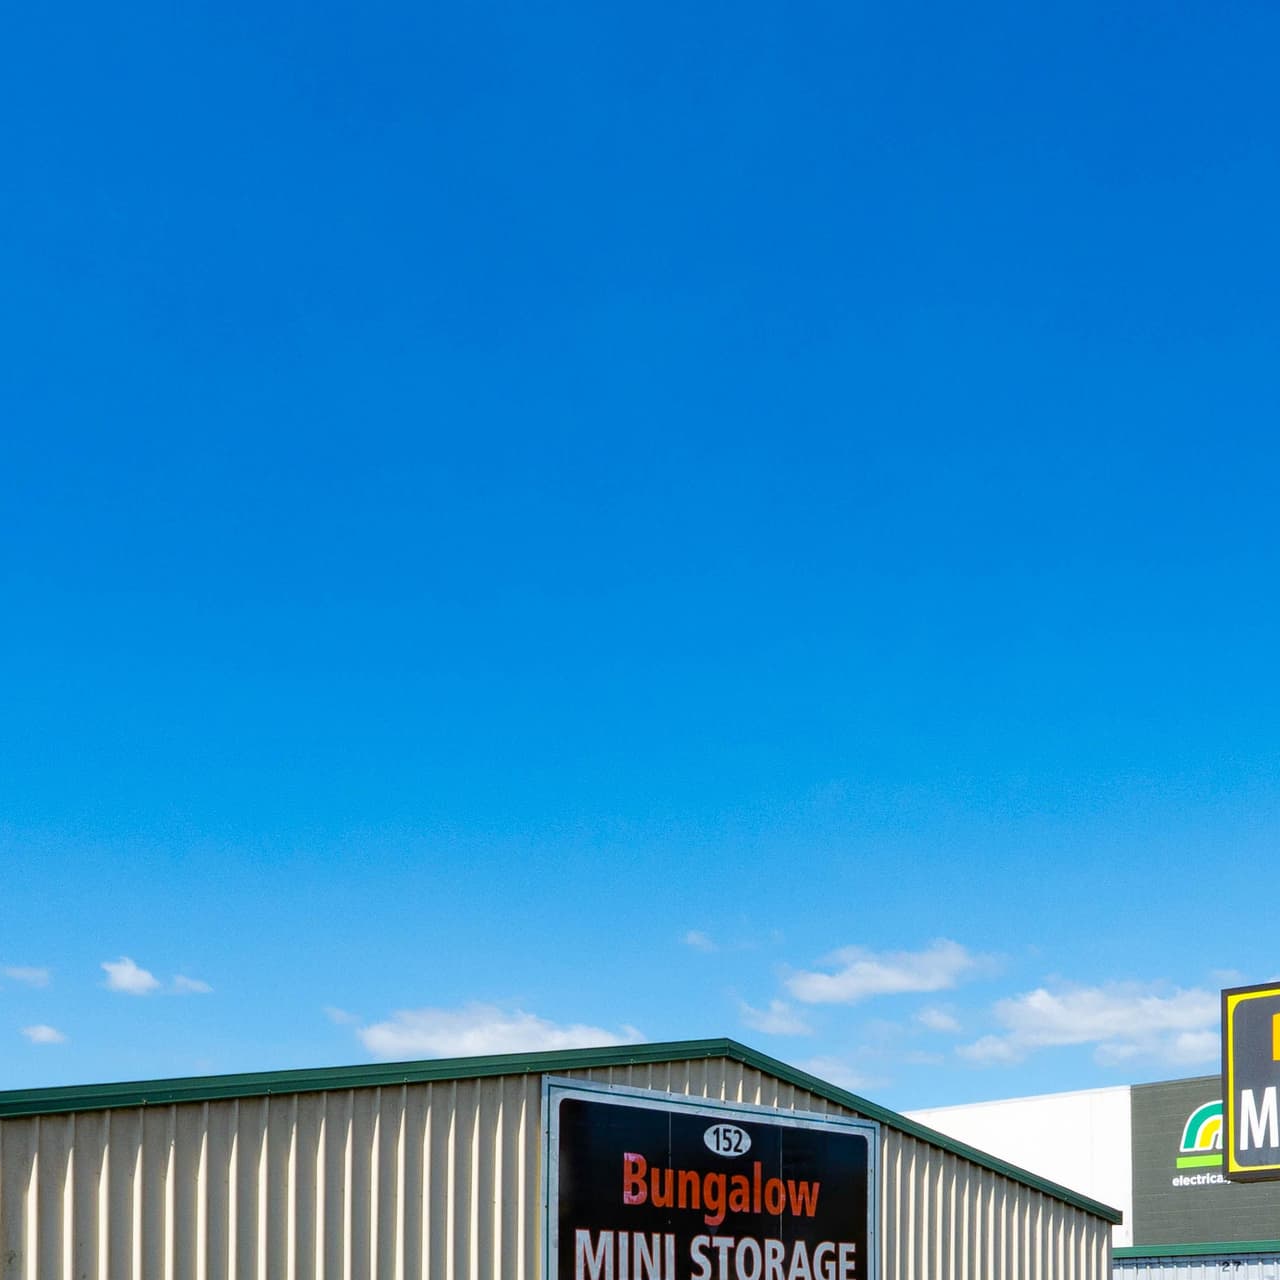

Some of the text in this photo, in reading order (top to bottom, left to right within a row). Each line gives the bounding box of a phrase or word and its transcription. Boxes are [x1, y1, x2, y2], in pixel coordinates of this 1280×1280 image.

[713, 1127, 743, 1153] 152
[623, 1152, 820, 1226] Bungalow
[1222, 1261, 1241, 1272] 27
